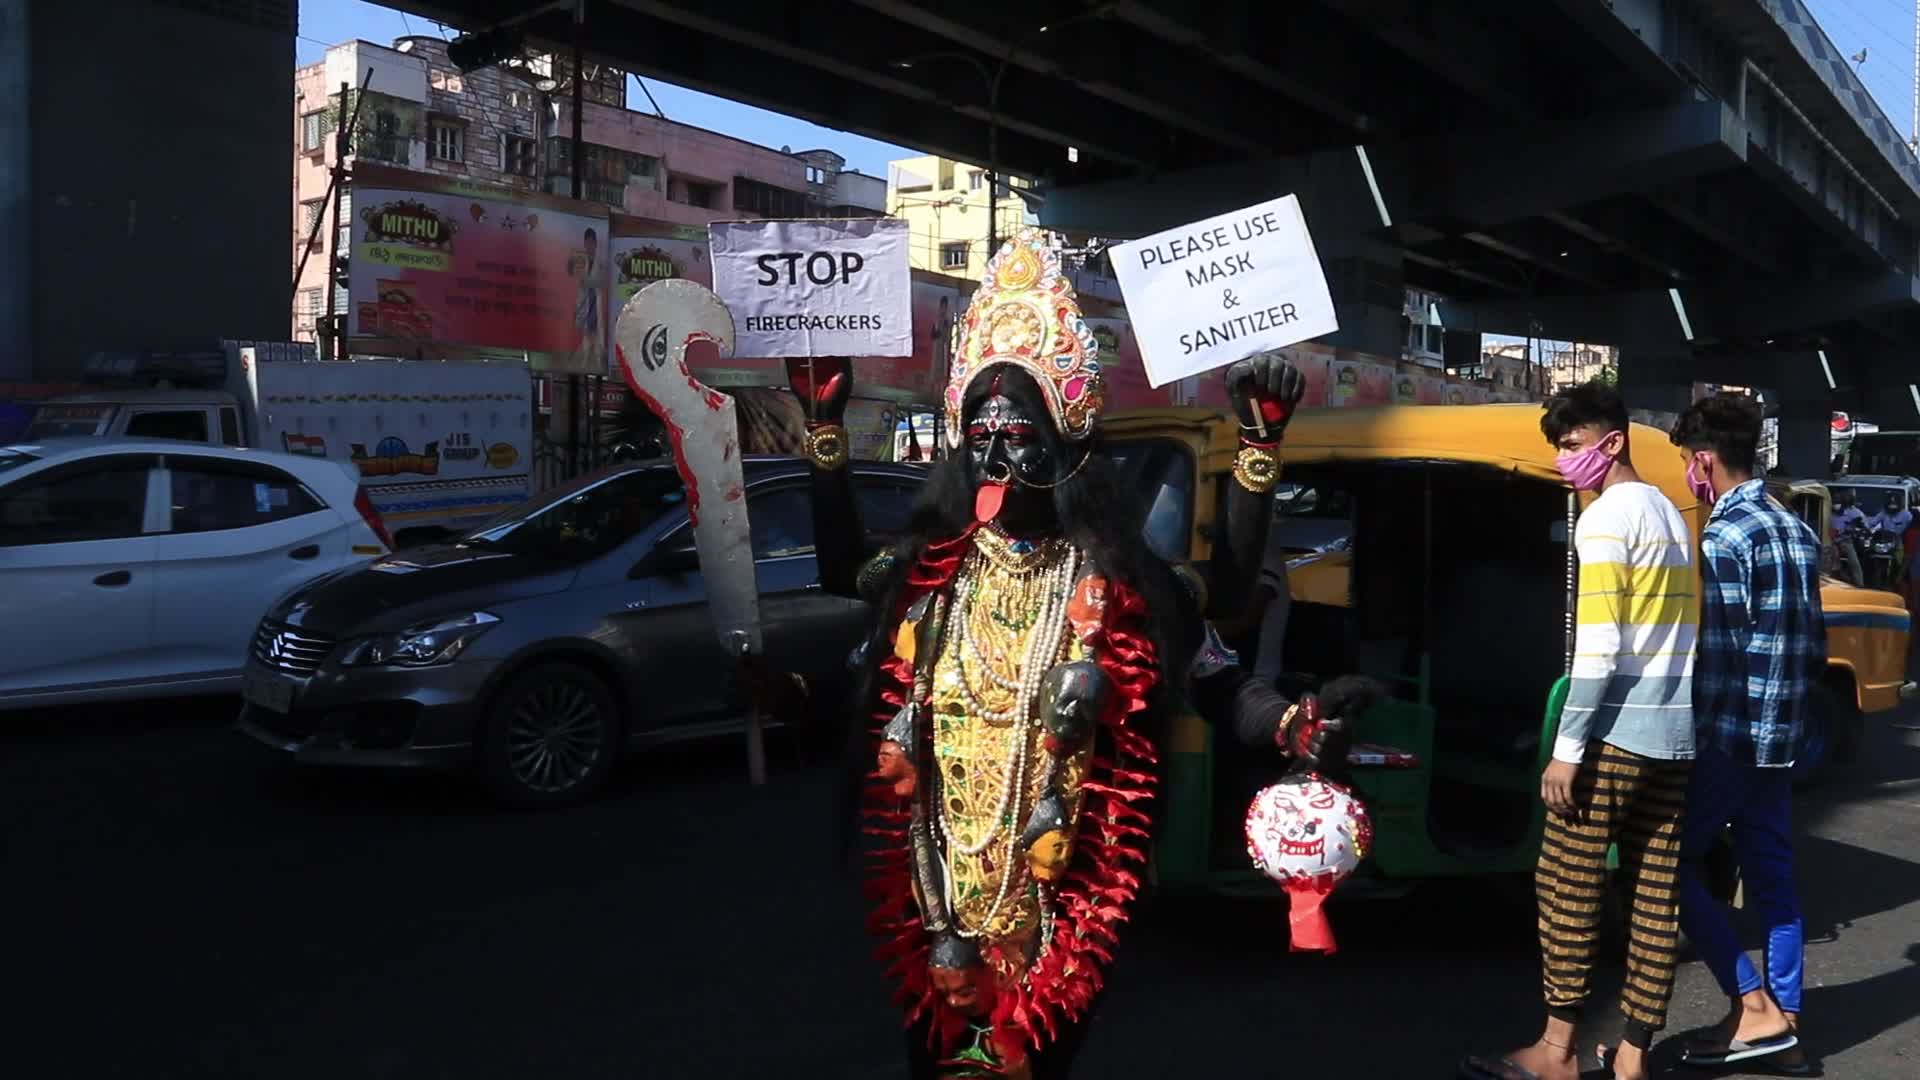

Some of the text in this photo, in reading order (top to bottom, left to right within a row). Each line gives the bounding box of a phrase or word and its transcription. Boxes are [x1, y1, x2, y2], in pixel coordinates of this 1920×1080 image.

[382, 213, 439, 238] MITHU
[1139, 212, 1280, 269] PLEASE USE
[631, 258, 672, 277] MITHU
[757, 251, 864, 286] STOP
[1185, 251, 1255, 288] MASK
[1222, 288, 1241, 309] &
[746, 315, 882, 331] FIRECRACKERS
[1179, 303, 1299, 355] SANITIZER
[446, 432, 471, 447] JIS
